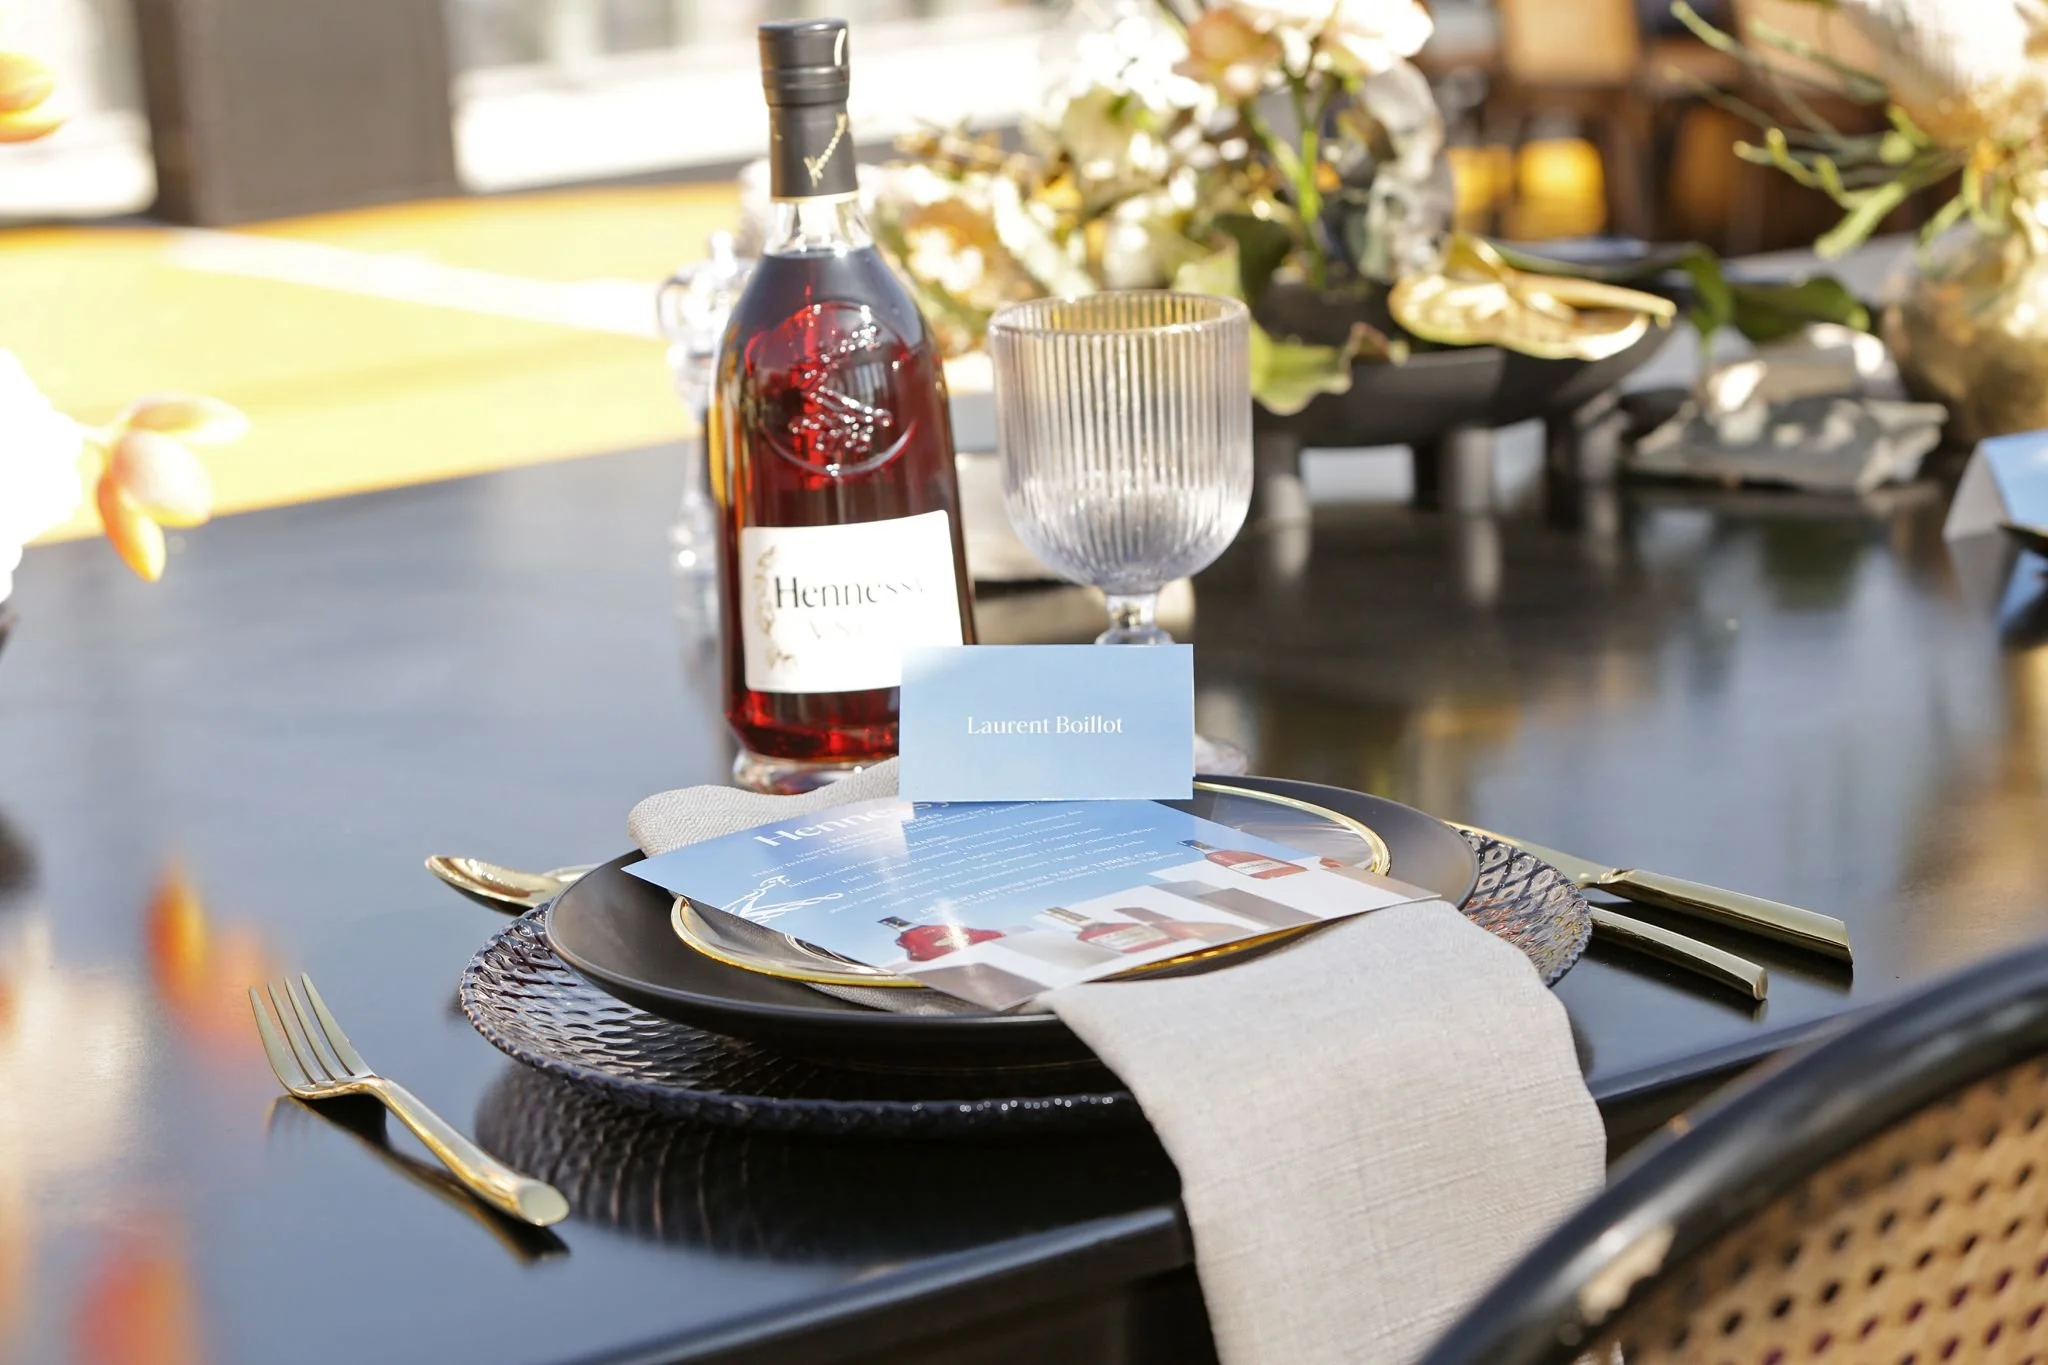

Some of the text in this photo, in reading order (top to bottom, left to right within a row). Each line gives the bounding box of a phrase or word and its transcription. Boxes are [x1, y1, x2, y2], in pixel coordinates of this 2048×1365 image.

[967, 715, 1123, 734] Laurent Boillot
[754, 801, 950, 847] Henne
